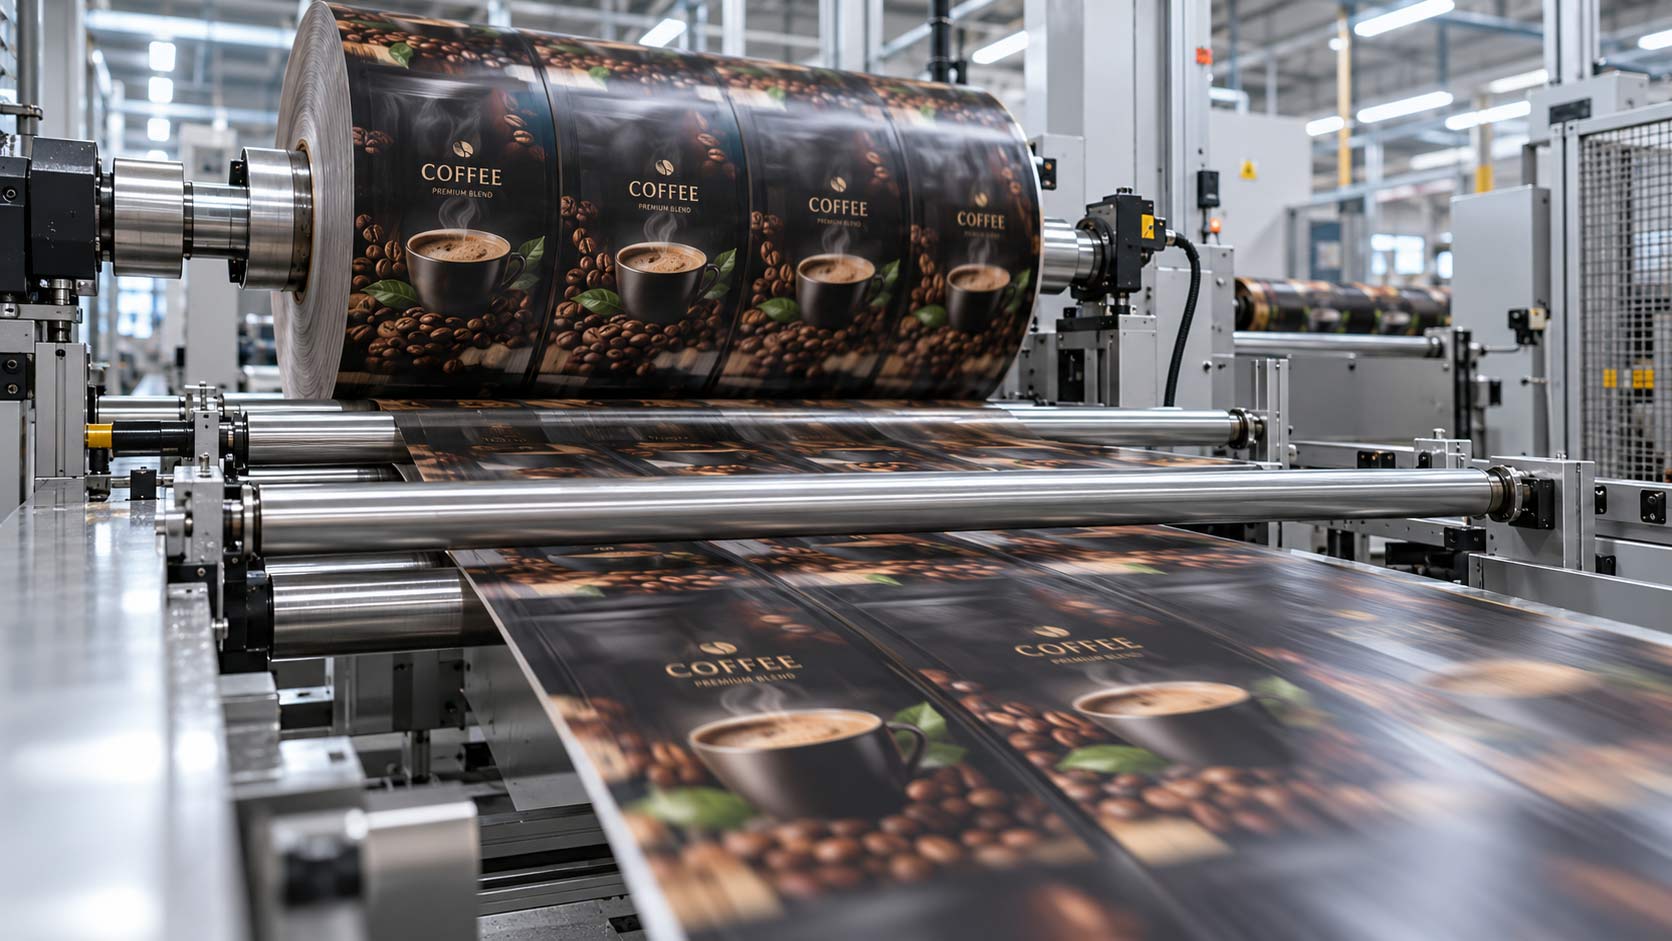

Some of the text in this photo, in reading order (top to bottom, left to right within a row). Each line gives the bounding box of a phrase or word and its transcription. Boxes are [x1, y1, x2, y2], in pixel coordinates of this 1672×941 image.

[421, 163, 502, 186] COFFEE
[432, 187, 493, 199] PREMIUM BLEND
[629, 180, 699, 202] COFFEE
[808, 197, 868, 217] COFFEE
[957, 211, 1006, 230] COFFEE
[1014, 637, 1144, 657] COFFEE
[665, 655, 802, 678] COFFEE
